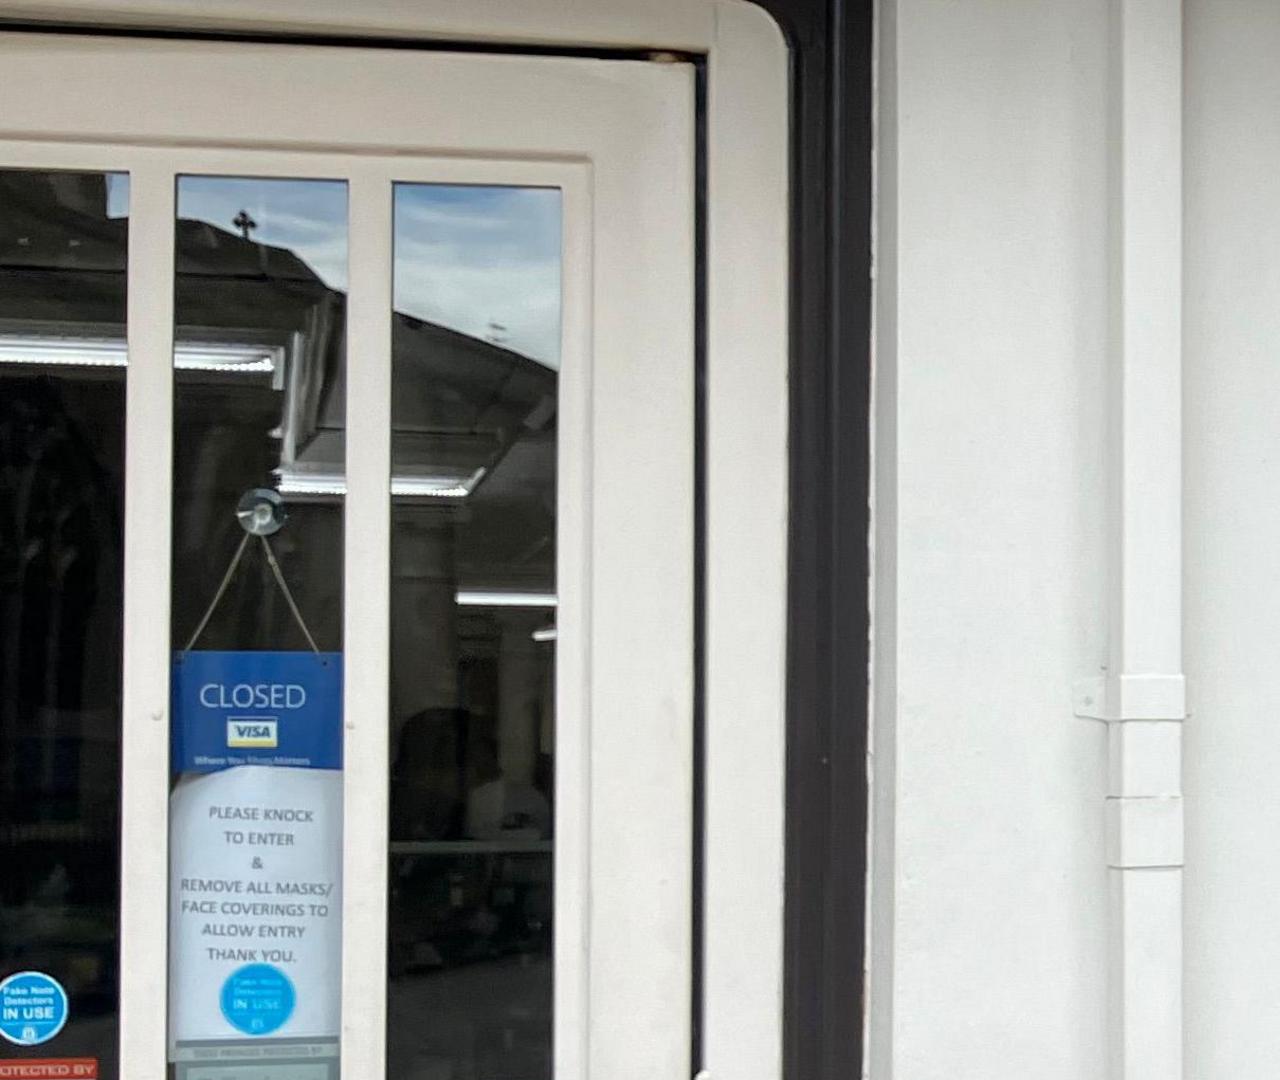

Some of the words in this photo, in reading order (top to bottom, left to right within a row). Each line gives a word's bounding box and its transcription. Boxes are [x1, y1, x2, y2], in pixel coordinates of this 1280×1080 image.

[200, 684, 306, 708] CLOSED
[235, 725, 271, 738] VISA
[209, 806, 259, 820] PLEASE
[263, 809, 314, 822] KNOCK
[224, 831, 244, 844] TO
[248, 832, 294, 845] ENTER
[251, 856, 263, 869] &
[181, 879, 242, 893] REMOVE
[246, 881, 271, 894] ALL
[276, 883, 333, 898] MASKS/
[181, 901, 217, 914] FACE
[221, 903, 305, 916] COVERINGS
[310, 905, 328, 917] TO
[202, 924, 254, 936] ALLOW
[258, 926, 306, 938] ENTRY
[206, 948, 257, 961] THANK
[261, 950, 297, 962] YOU.
[3, 1008, 18, 1020] IN
[23, 1007, 54, 1020] USE
[0, 1065, 70, 1077] OTECTED
[73, 1064, 95, 1075] BY
